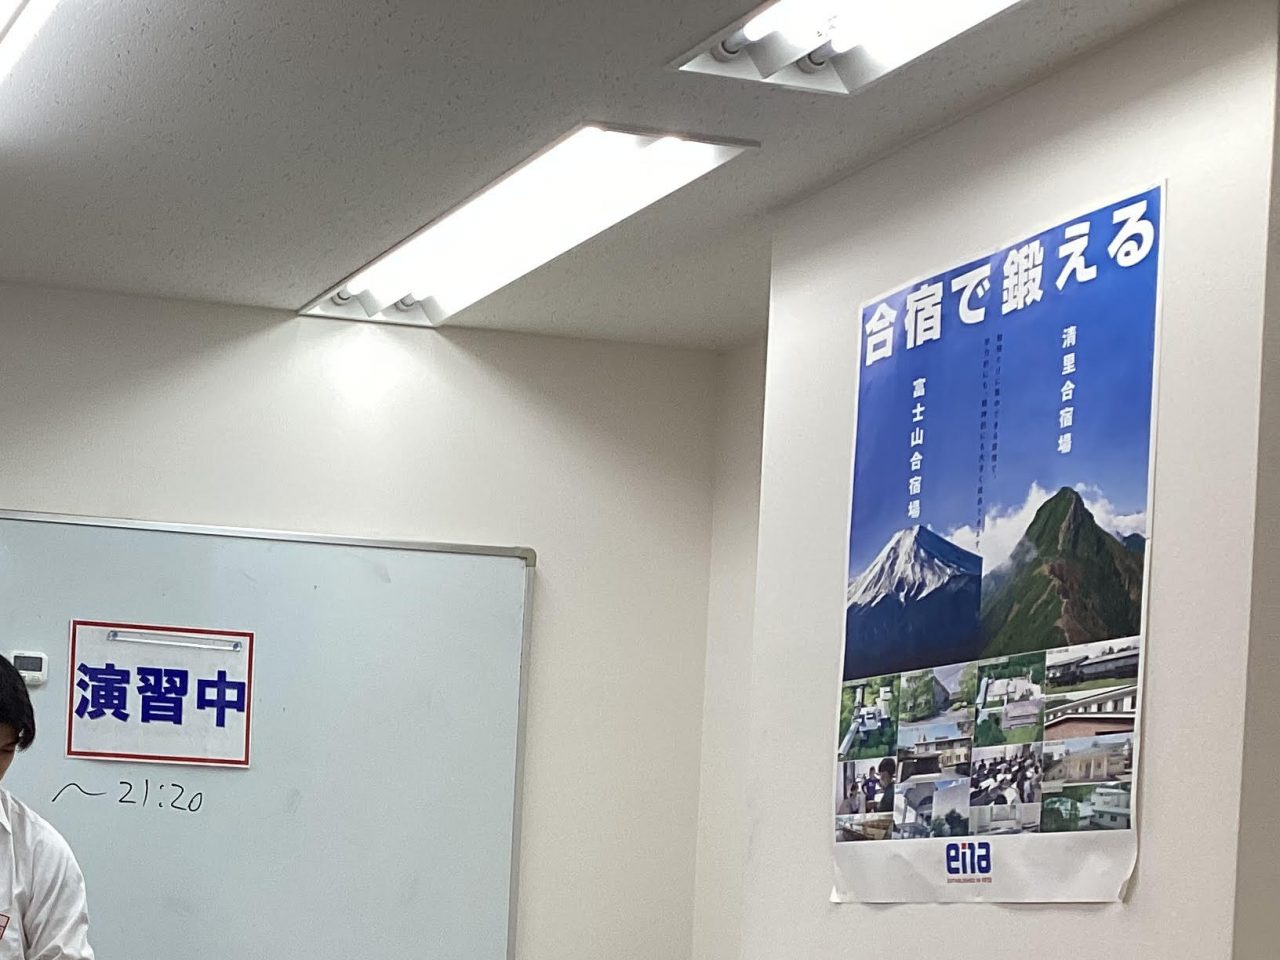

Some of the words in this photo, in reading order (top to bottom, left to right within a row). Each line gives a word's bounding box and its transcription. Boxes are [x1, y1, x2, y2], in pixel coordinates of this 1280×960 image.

[865, 199, 1155, 367] 合宿で鍛える
[907, 377, 926, 518] 富士山合宿場
[1057, 325, 1077, 454] 清里合宿場
[74, 662, 246, 728] 演習中
